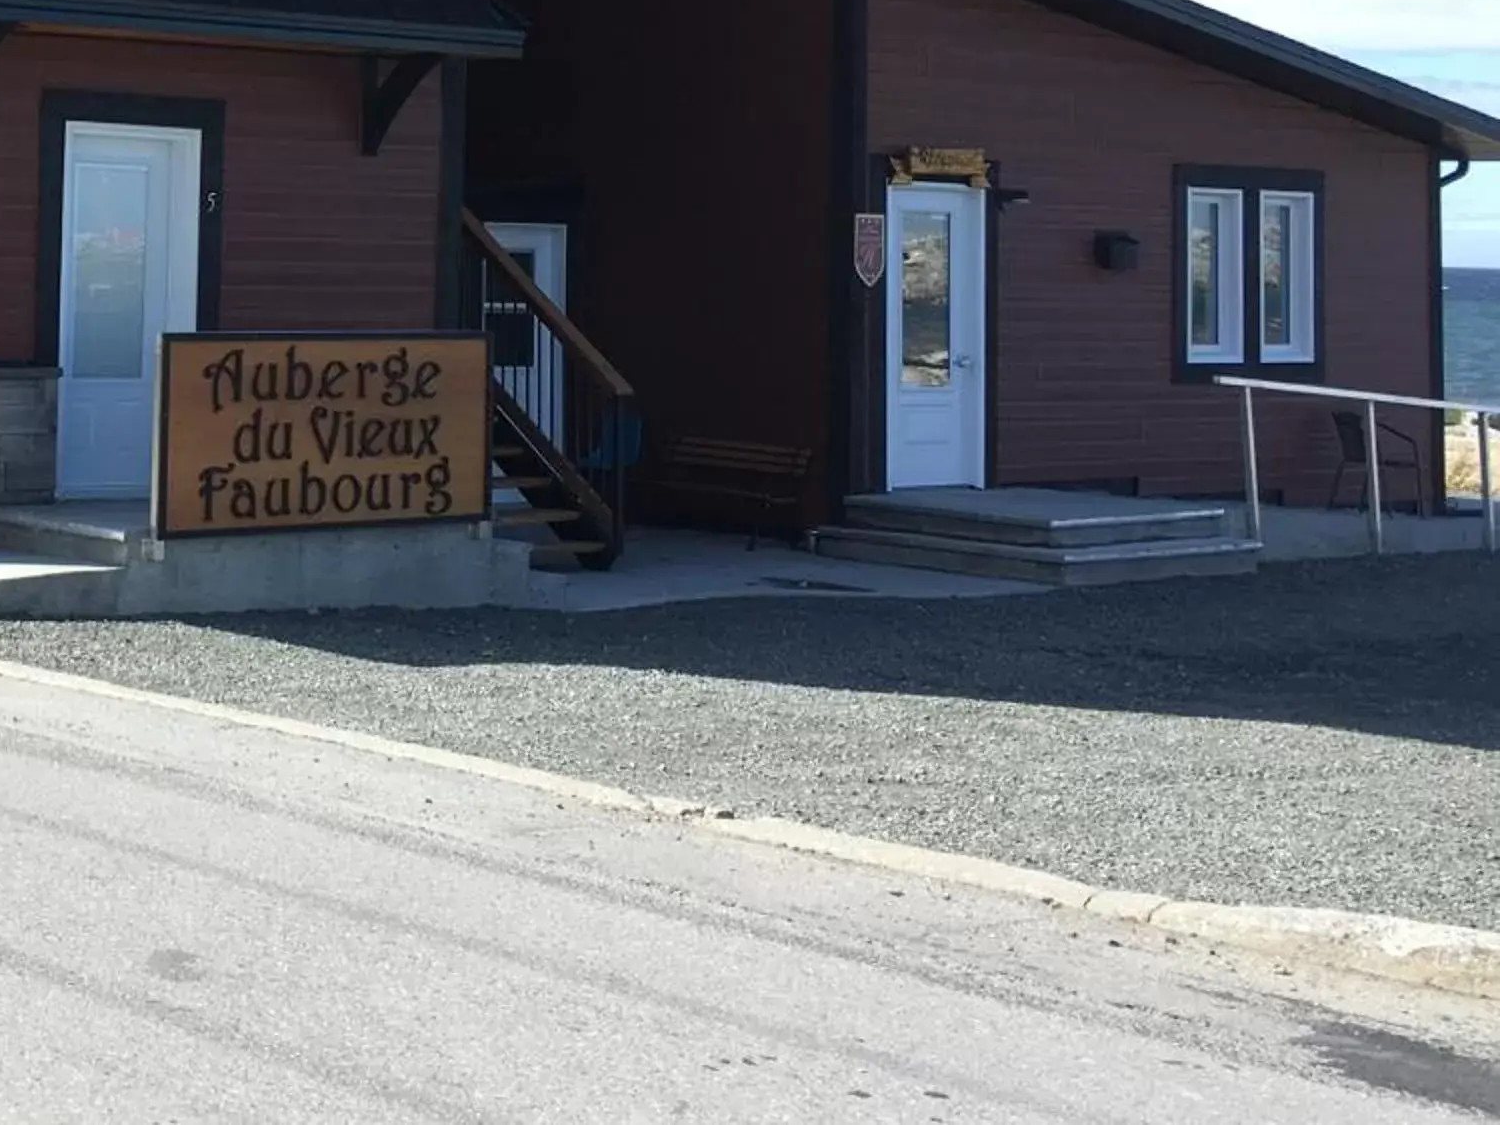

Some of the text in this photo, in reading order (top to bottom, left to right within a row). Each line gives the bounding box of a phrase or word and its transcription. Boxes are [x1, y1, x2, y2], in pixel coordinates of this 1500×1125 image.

[207, 192, 217, 212] 5
[203, 345, 442, 412] Auberge
[233, 406, 441, 464] du Vieux
[198, 456, 452, 521] Faubourg
